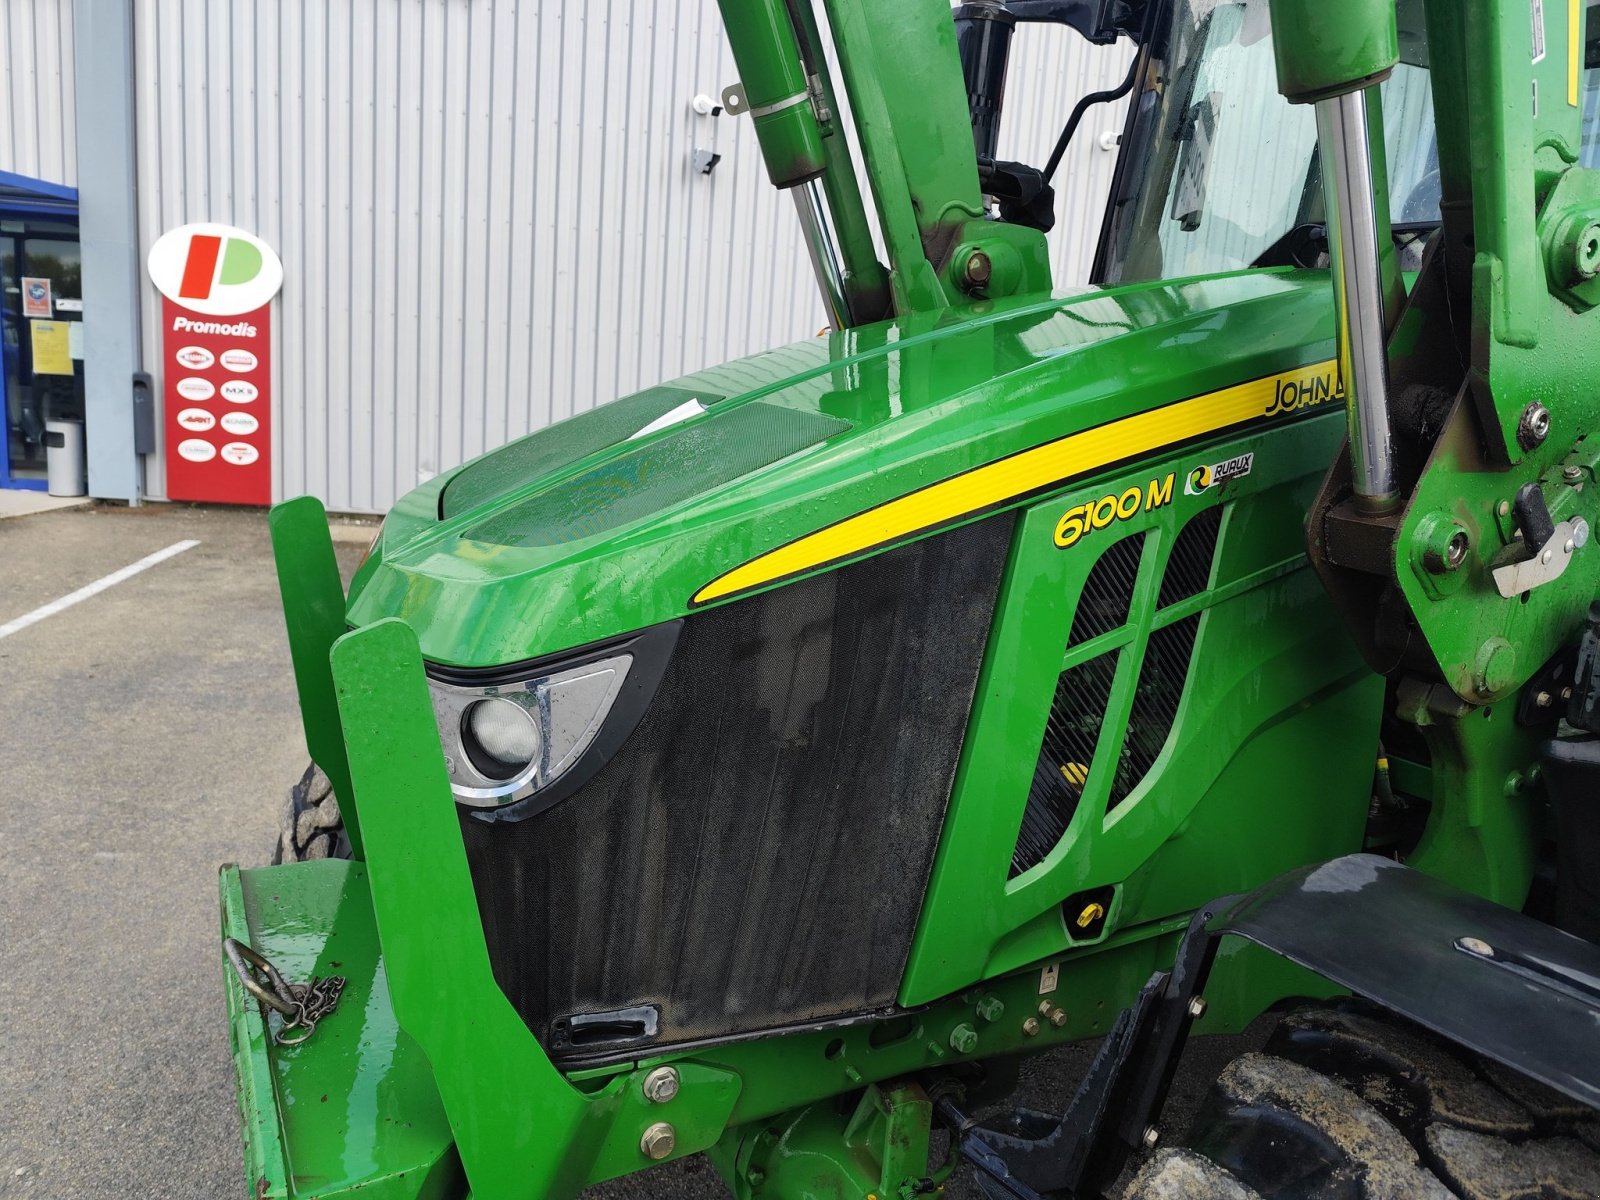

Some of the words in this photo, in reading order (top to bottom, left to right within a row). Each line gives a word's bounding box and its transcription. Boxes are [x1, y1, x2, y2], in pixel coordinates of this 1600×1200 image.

[173, 316, 257, 337] Promodis
[1264, 373, 1331, 415] JOHN
[1214, 454, 1252, 477] RUAUX
[1052, 487, 1142, 550] 6100
[1145, 472, 1176, 512] M
